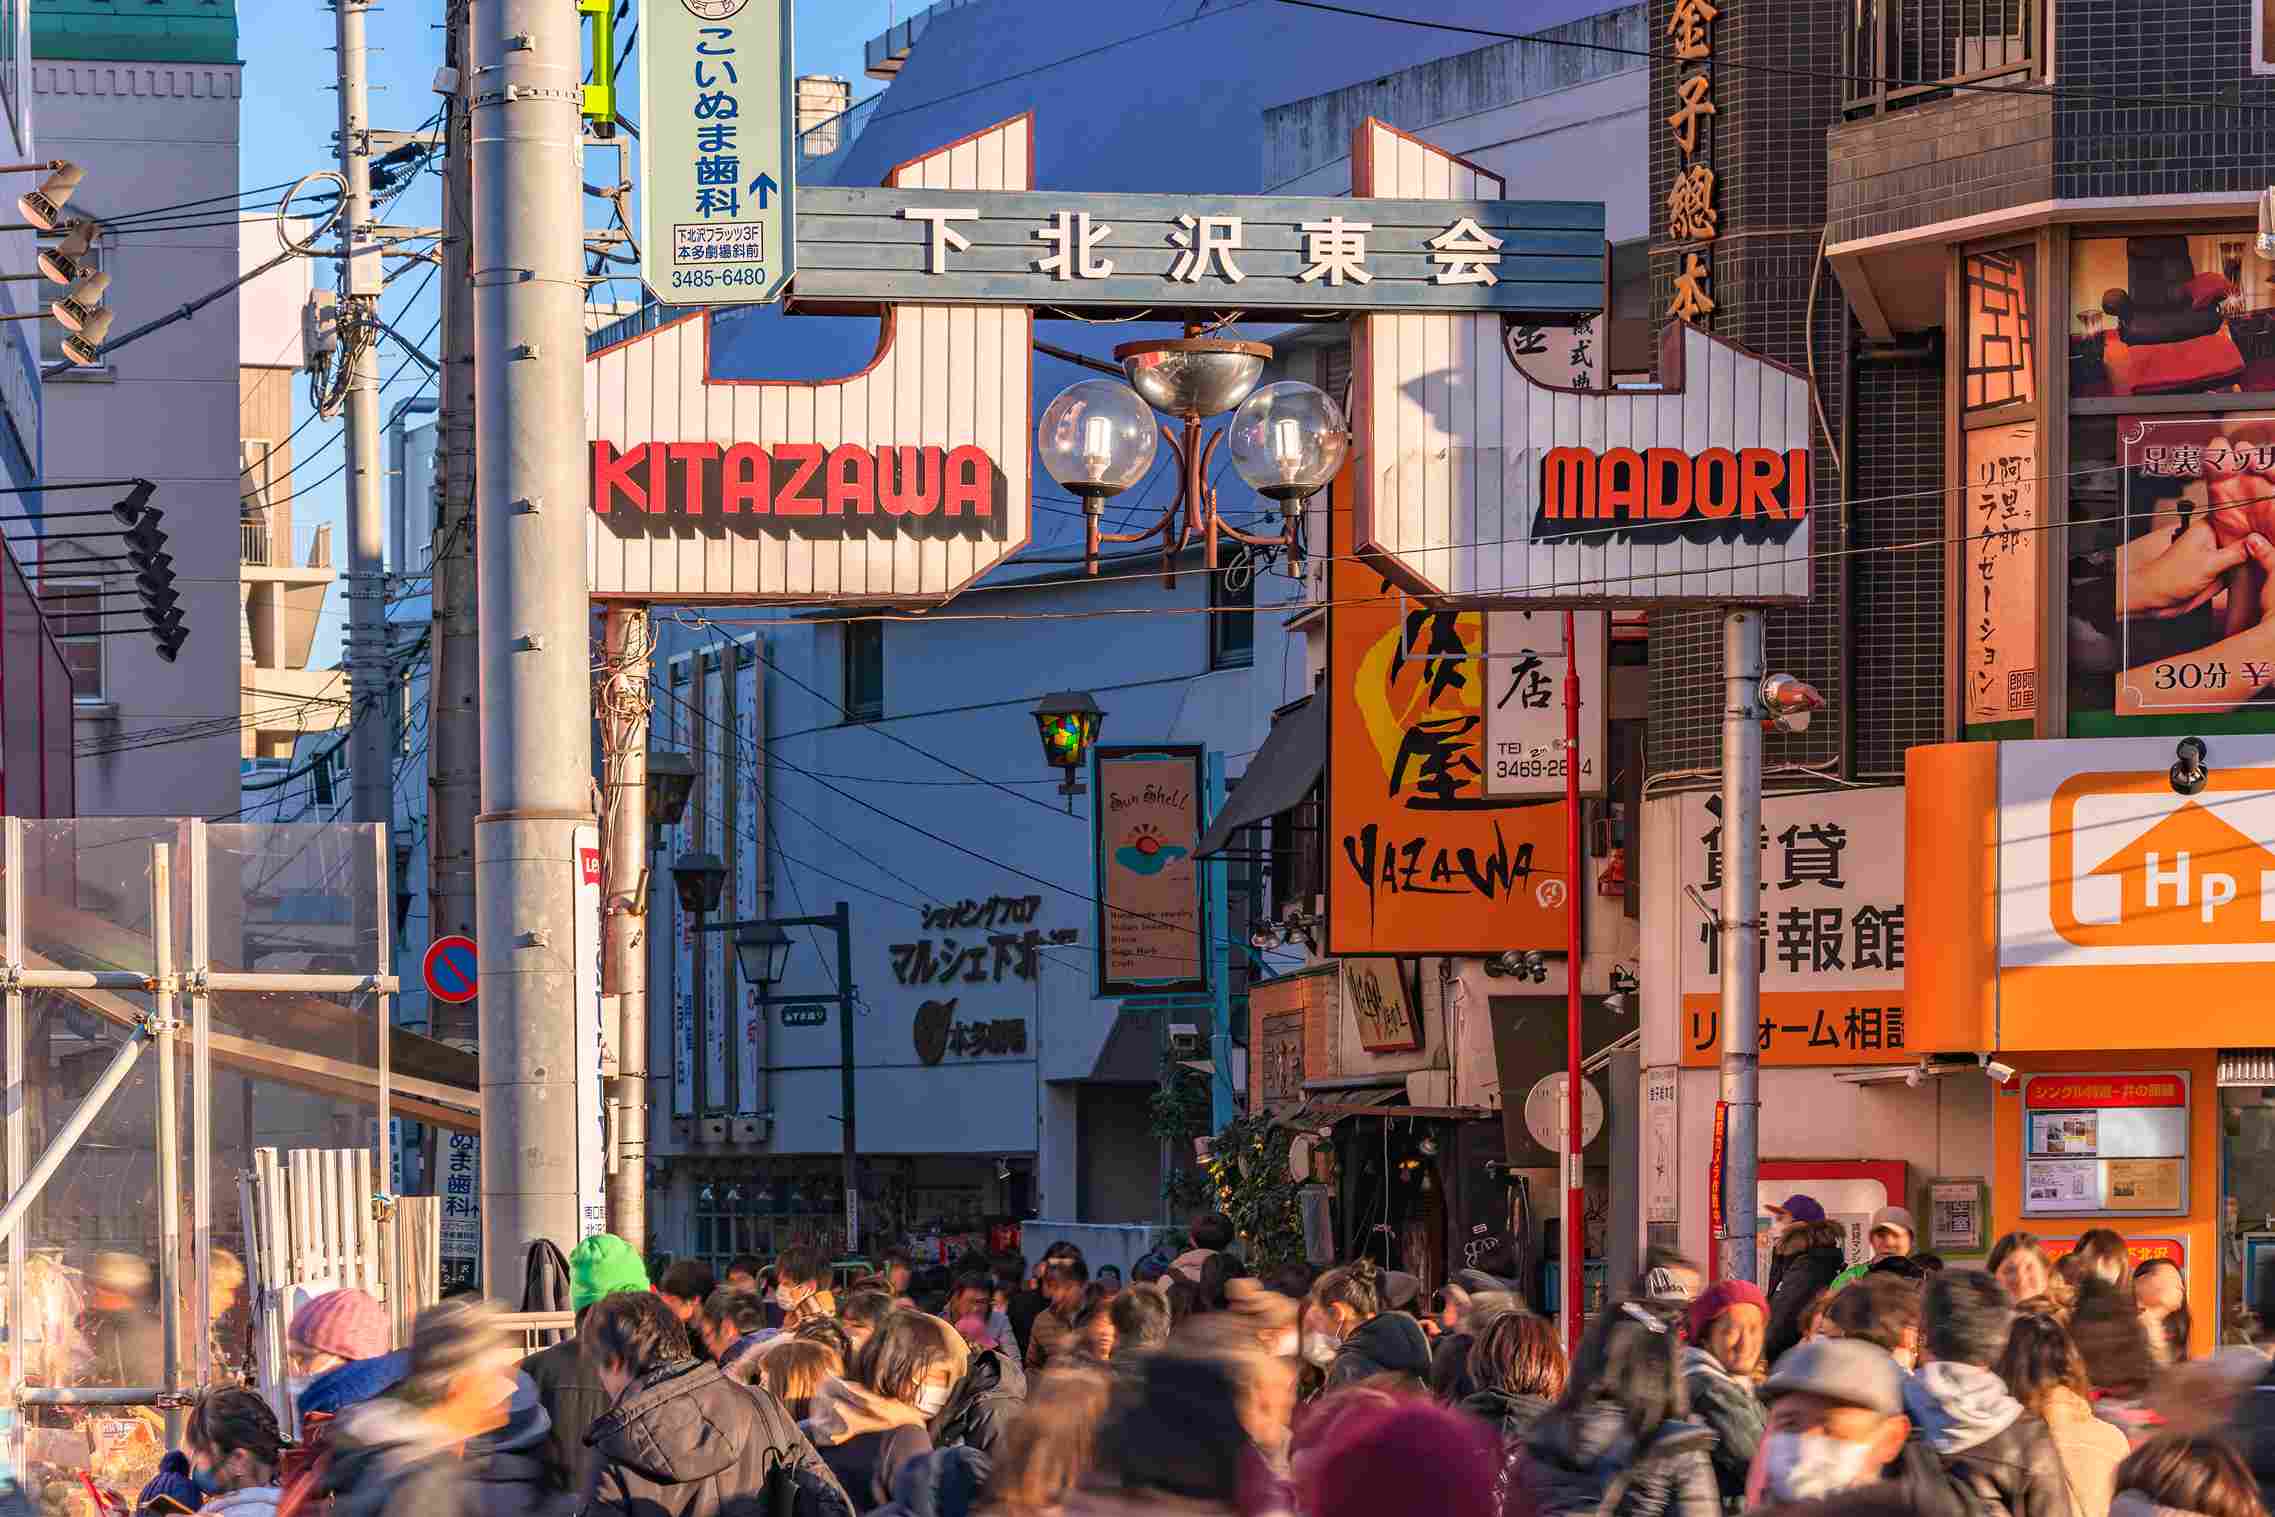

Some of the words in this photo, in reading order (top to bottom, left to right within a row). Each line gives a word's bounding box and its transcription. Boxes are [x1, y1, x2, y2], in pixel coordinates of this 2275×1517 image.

[694, 27, 741, 218] こいぬま歯科
[678, 225, 760, 244] 下北沢フラッツ3F
[904, 206, 1506, 287] 下北沢東会
[671, 267, 766, 290] 3485-6480
[591, 440, 993, 516] KITAZAWA
[1544, 446, 1808, 520] MADORI
[1977, 461, 1999, 696] リラクゼーション
[1497, 648, 1553, 709] 店
[2155, 662, 2231, 690] 30分
[1343, 819, 1537, 938] YAZAWA
[1693, 1006, 1905, 1051] リォーム相
